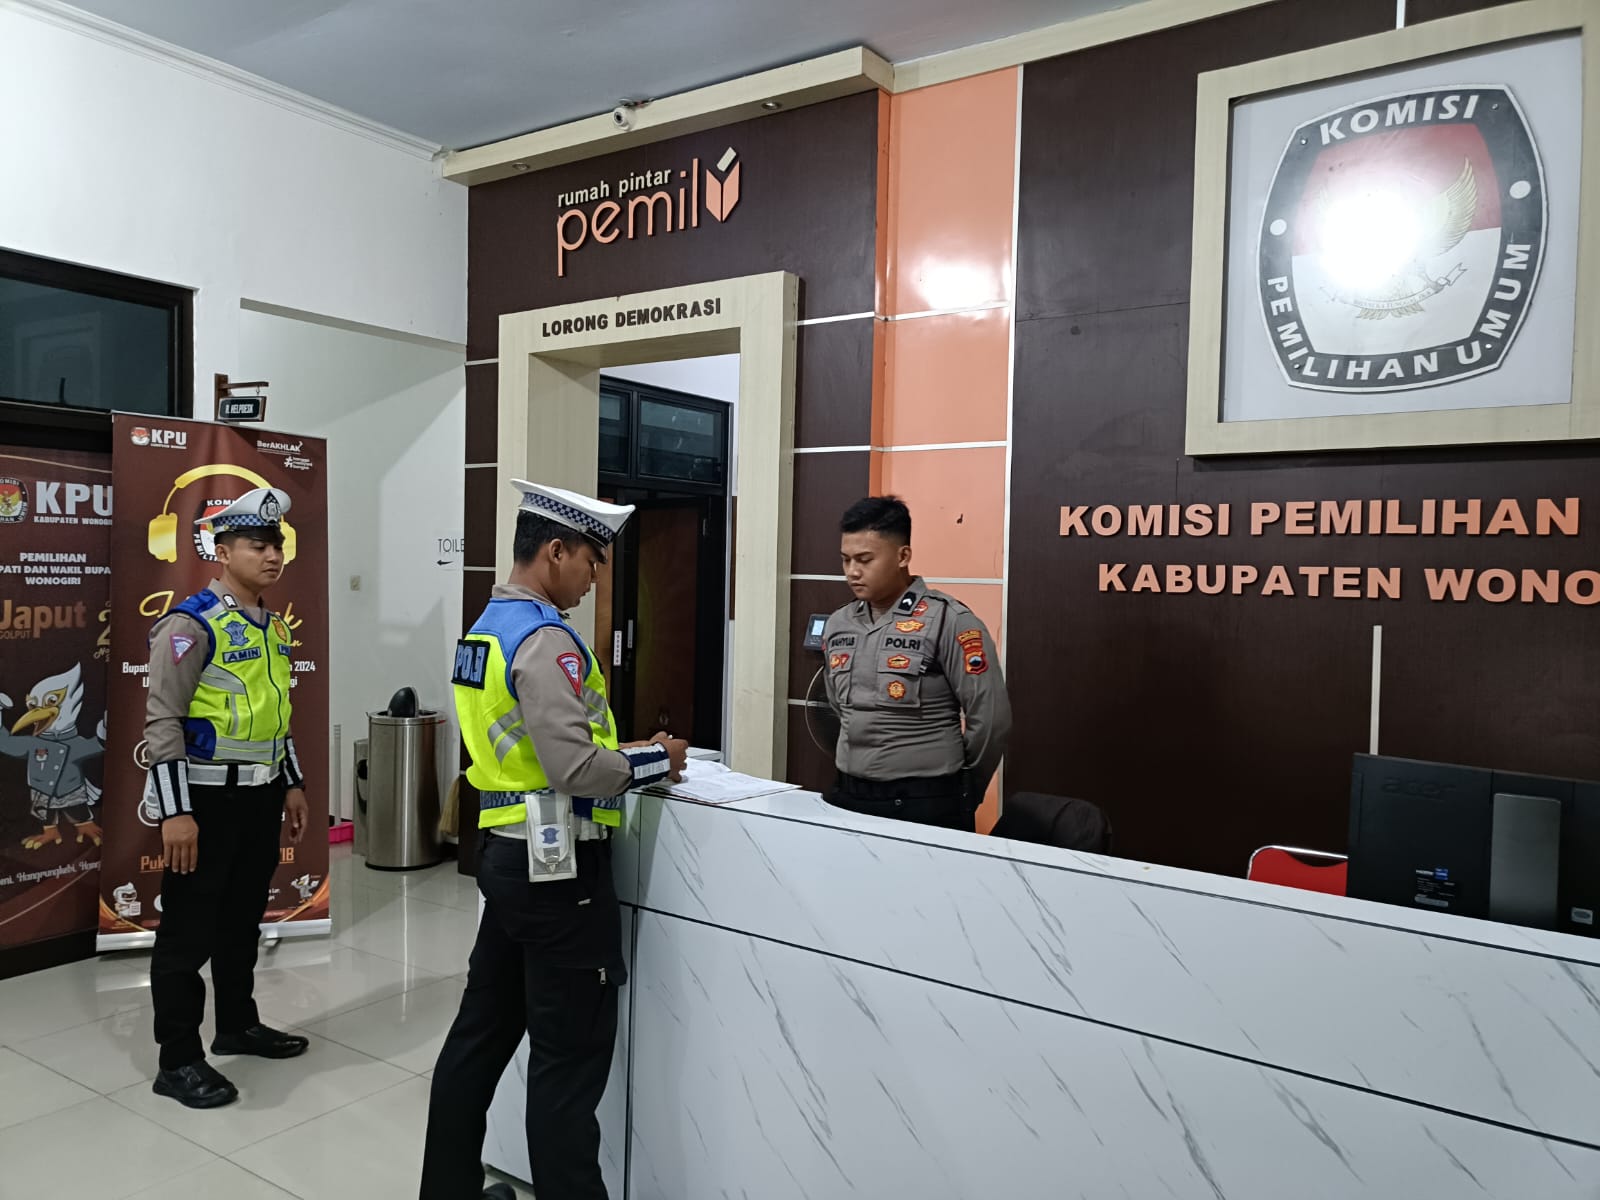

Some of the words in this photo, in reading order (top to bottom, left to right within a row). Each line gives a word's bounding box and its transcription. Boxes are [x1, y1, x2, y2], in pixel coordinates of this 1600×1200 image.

[1319, 95, 1479, 145] KOMISI
[557, 180, 610, 207] rumah
[618, 168, 672, 198] pintar
[542, 313, 609, 337] LORONG
[615, 298, 721, 328] DEMOKRASI
[1456, 243, 1532, 366] UMUM
[1267, 275, 1439, 381] PEMILIHAN
[151, 428, 187, 446] KPU
[256, 440, 303, 453] BerAKHLAK
[36, 481, 113, 517] KPU
[1059, 503, 1231, 537] KOMISI
[1250, 497, 1580, 536] PEMILIHAN
[20, 552, 87, 563] PEMILIHAN
[24, 565, 48, 574] DAN
[50, 565, 82, 574] WAKIL
[85, 566, 111, 574] BUPA
[25, 576, 81, 585] WONOGIRI
[1098, 564, 1401, 600] KABUPATEN
[228, 648, 259, 662] AMIN
[885, 637, 921, 651] POLRI
[294, 661, 316, 672] 2024
